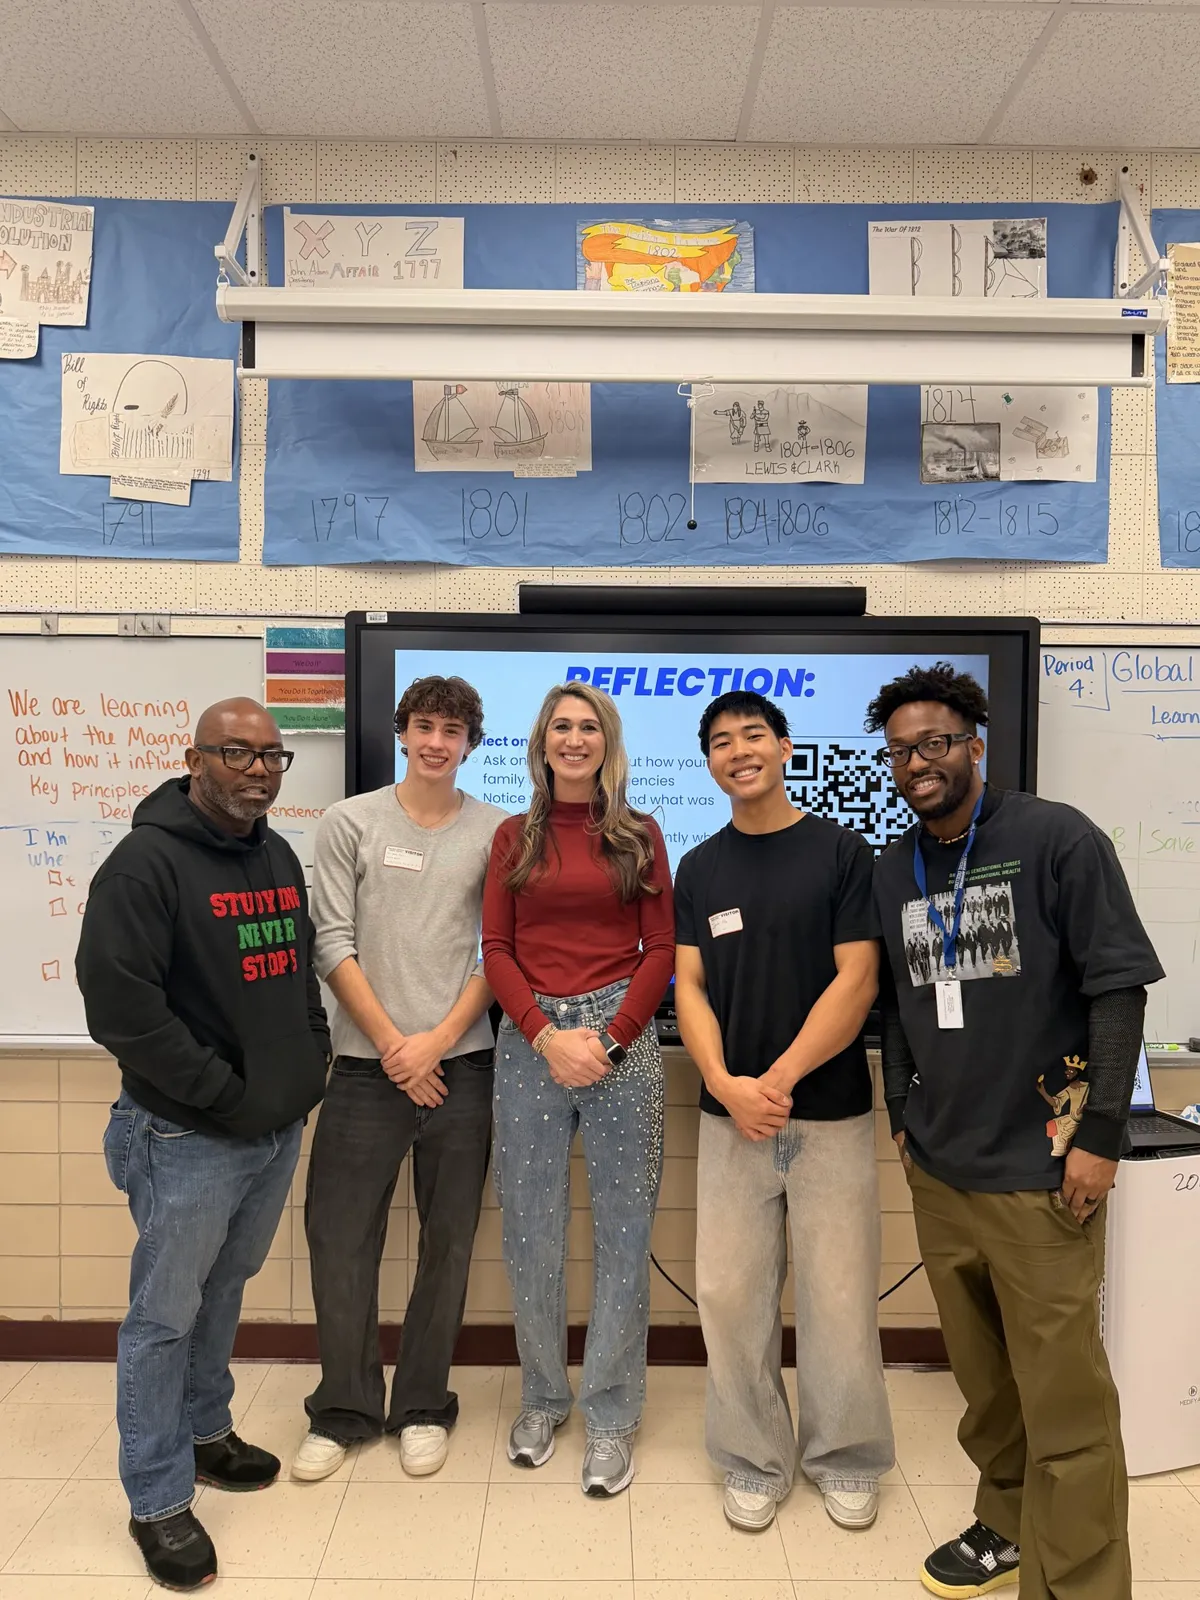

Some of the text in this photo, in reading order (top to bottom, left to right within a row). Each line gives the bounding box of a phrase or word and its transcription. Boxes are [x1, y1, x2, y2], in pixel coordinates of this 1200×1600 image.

[393, 259, 441, 280] 1797
[63, 354, 84, 373] Bill
[83, 394, 107, 416] Rights
[780, 439, 855, 458] 1804-1806
[191, 469, 210, 480] 1791
[745, 462, 787, 475] LEWIS
[102, 502, 154, 546] 1791
[311, 494, 389, 542] 1797
[462, 488, 527, 547] 1801
[618, 492, 686, 548] 1802
[724, 497, 829, 546] 1804-1806
[934, 499, 1059, 536] 1812-1815
[1044, 652, 1193, 682] Period Global
[8, 688, 190, 729] We are learning
[15, 724, 196, 756] about the Magna
[18, 747, 52, 767] and
[64, 747, 99, 769] how
[106, 752, 121, 769] it
[483, 754, 506, 766] Ask
[646, 756, 674, 767] how
[30, 774, 151, 805] Key principles
[483, 773, 675, 787] family encies
[483, 792, 526, 804] Notice
[650, 794, 684, 805] what
[687, 796, 715, 805] was
[1147, 829, 1195, 854] Save
[209, 885, 300, 918] STUDYING
[237, 917, 297, 950] NEVER
[242, 948, 298, 982] STOPS
